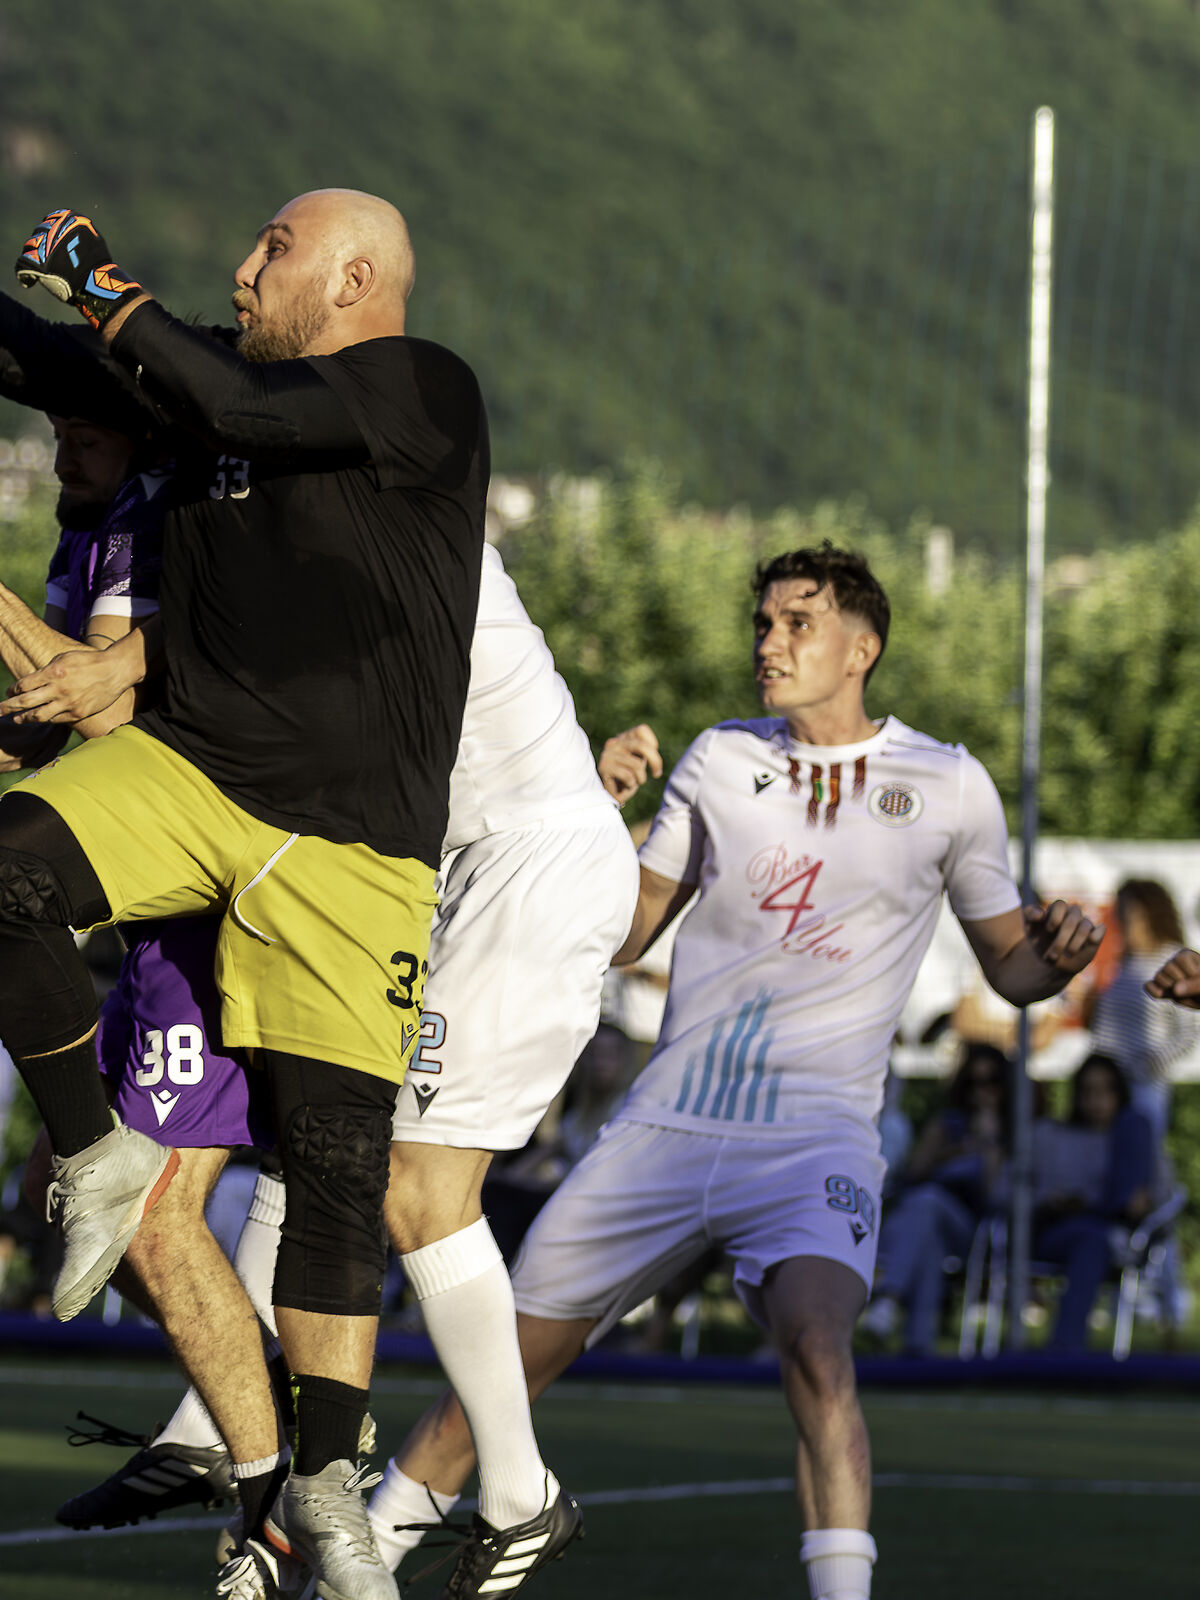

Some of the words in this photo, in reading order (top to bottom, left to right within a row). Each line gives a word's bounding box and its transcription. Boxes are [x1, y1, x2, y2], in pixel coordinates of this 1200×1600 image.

[759, 858, 823, 941] 4
[386, 950, 429, 1017] 3
[135, 1023, 205, 1087] 38
